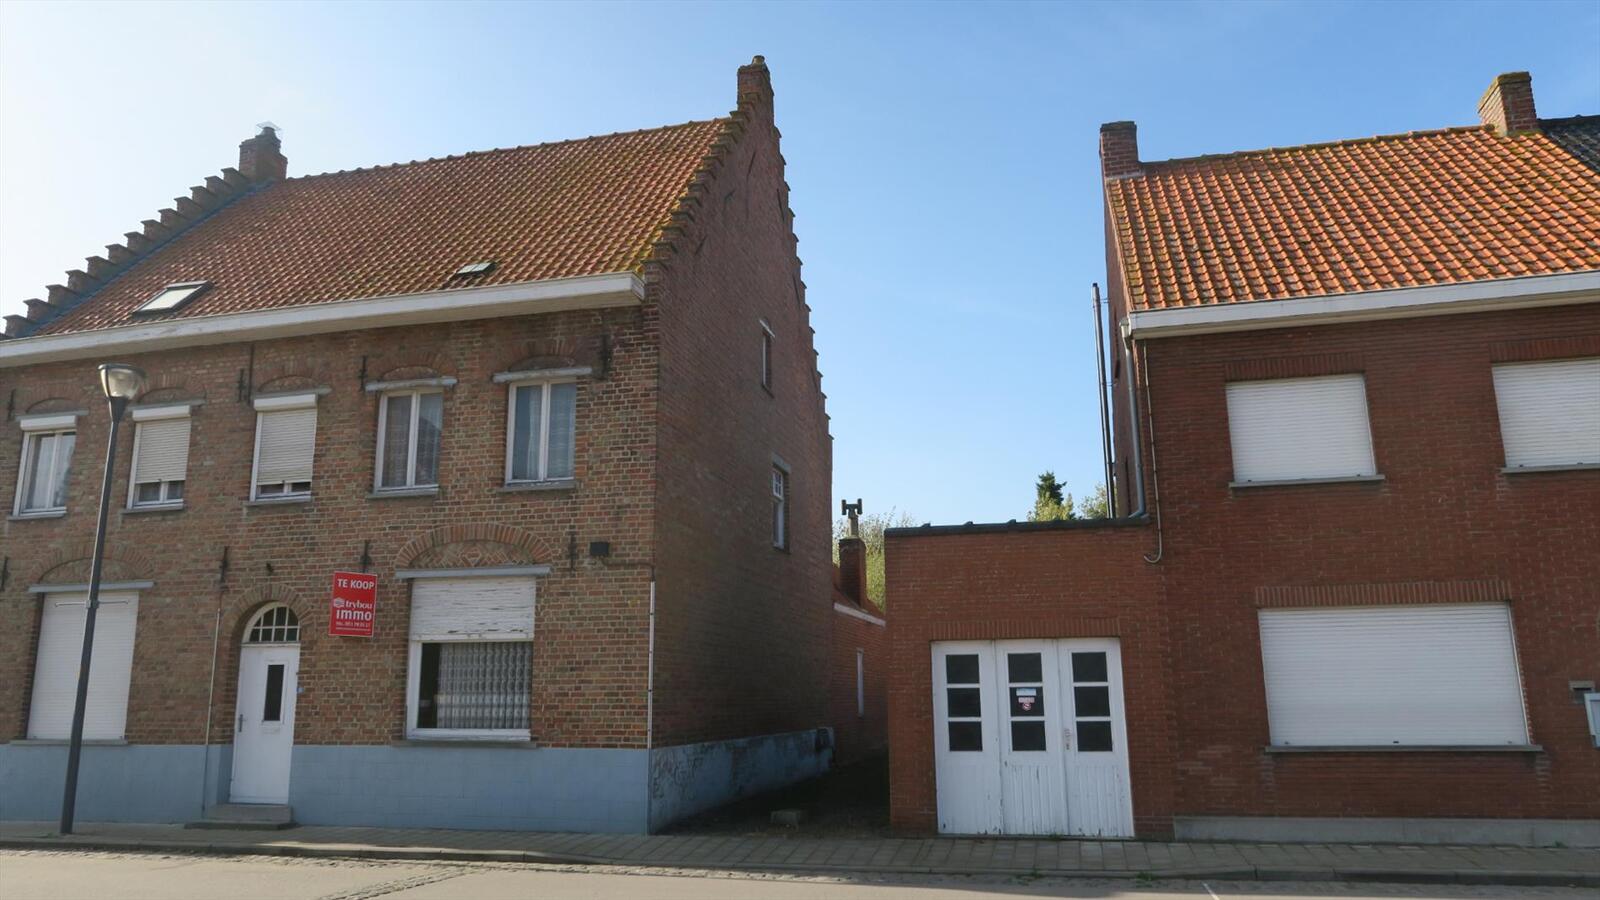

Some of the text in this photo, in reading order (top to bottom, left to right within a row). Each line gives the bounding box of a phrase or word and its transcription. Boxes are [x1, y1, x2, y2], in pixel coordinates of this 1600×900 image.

[337, 578, 375, 590] TE KOOP
[345, 599, 373, 610] trybou
[336, 609, 372, 621] immo
